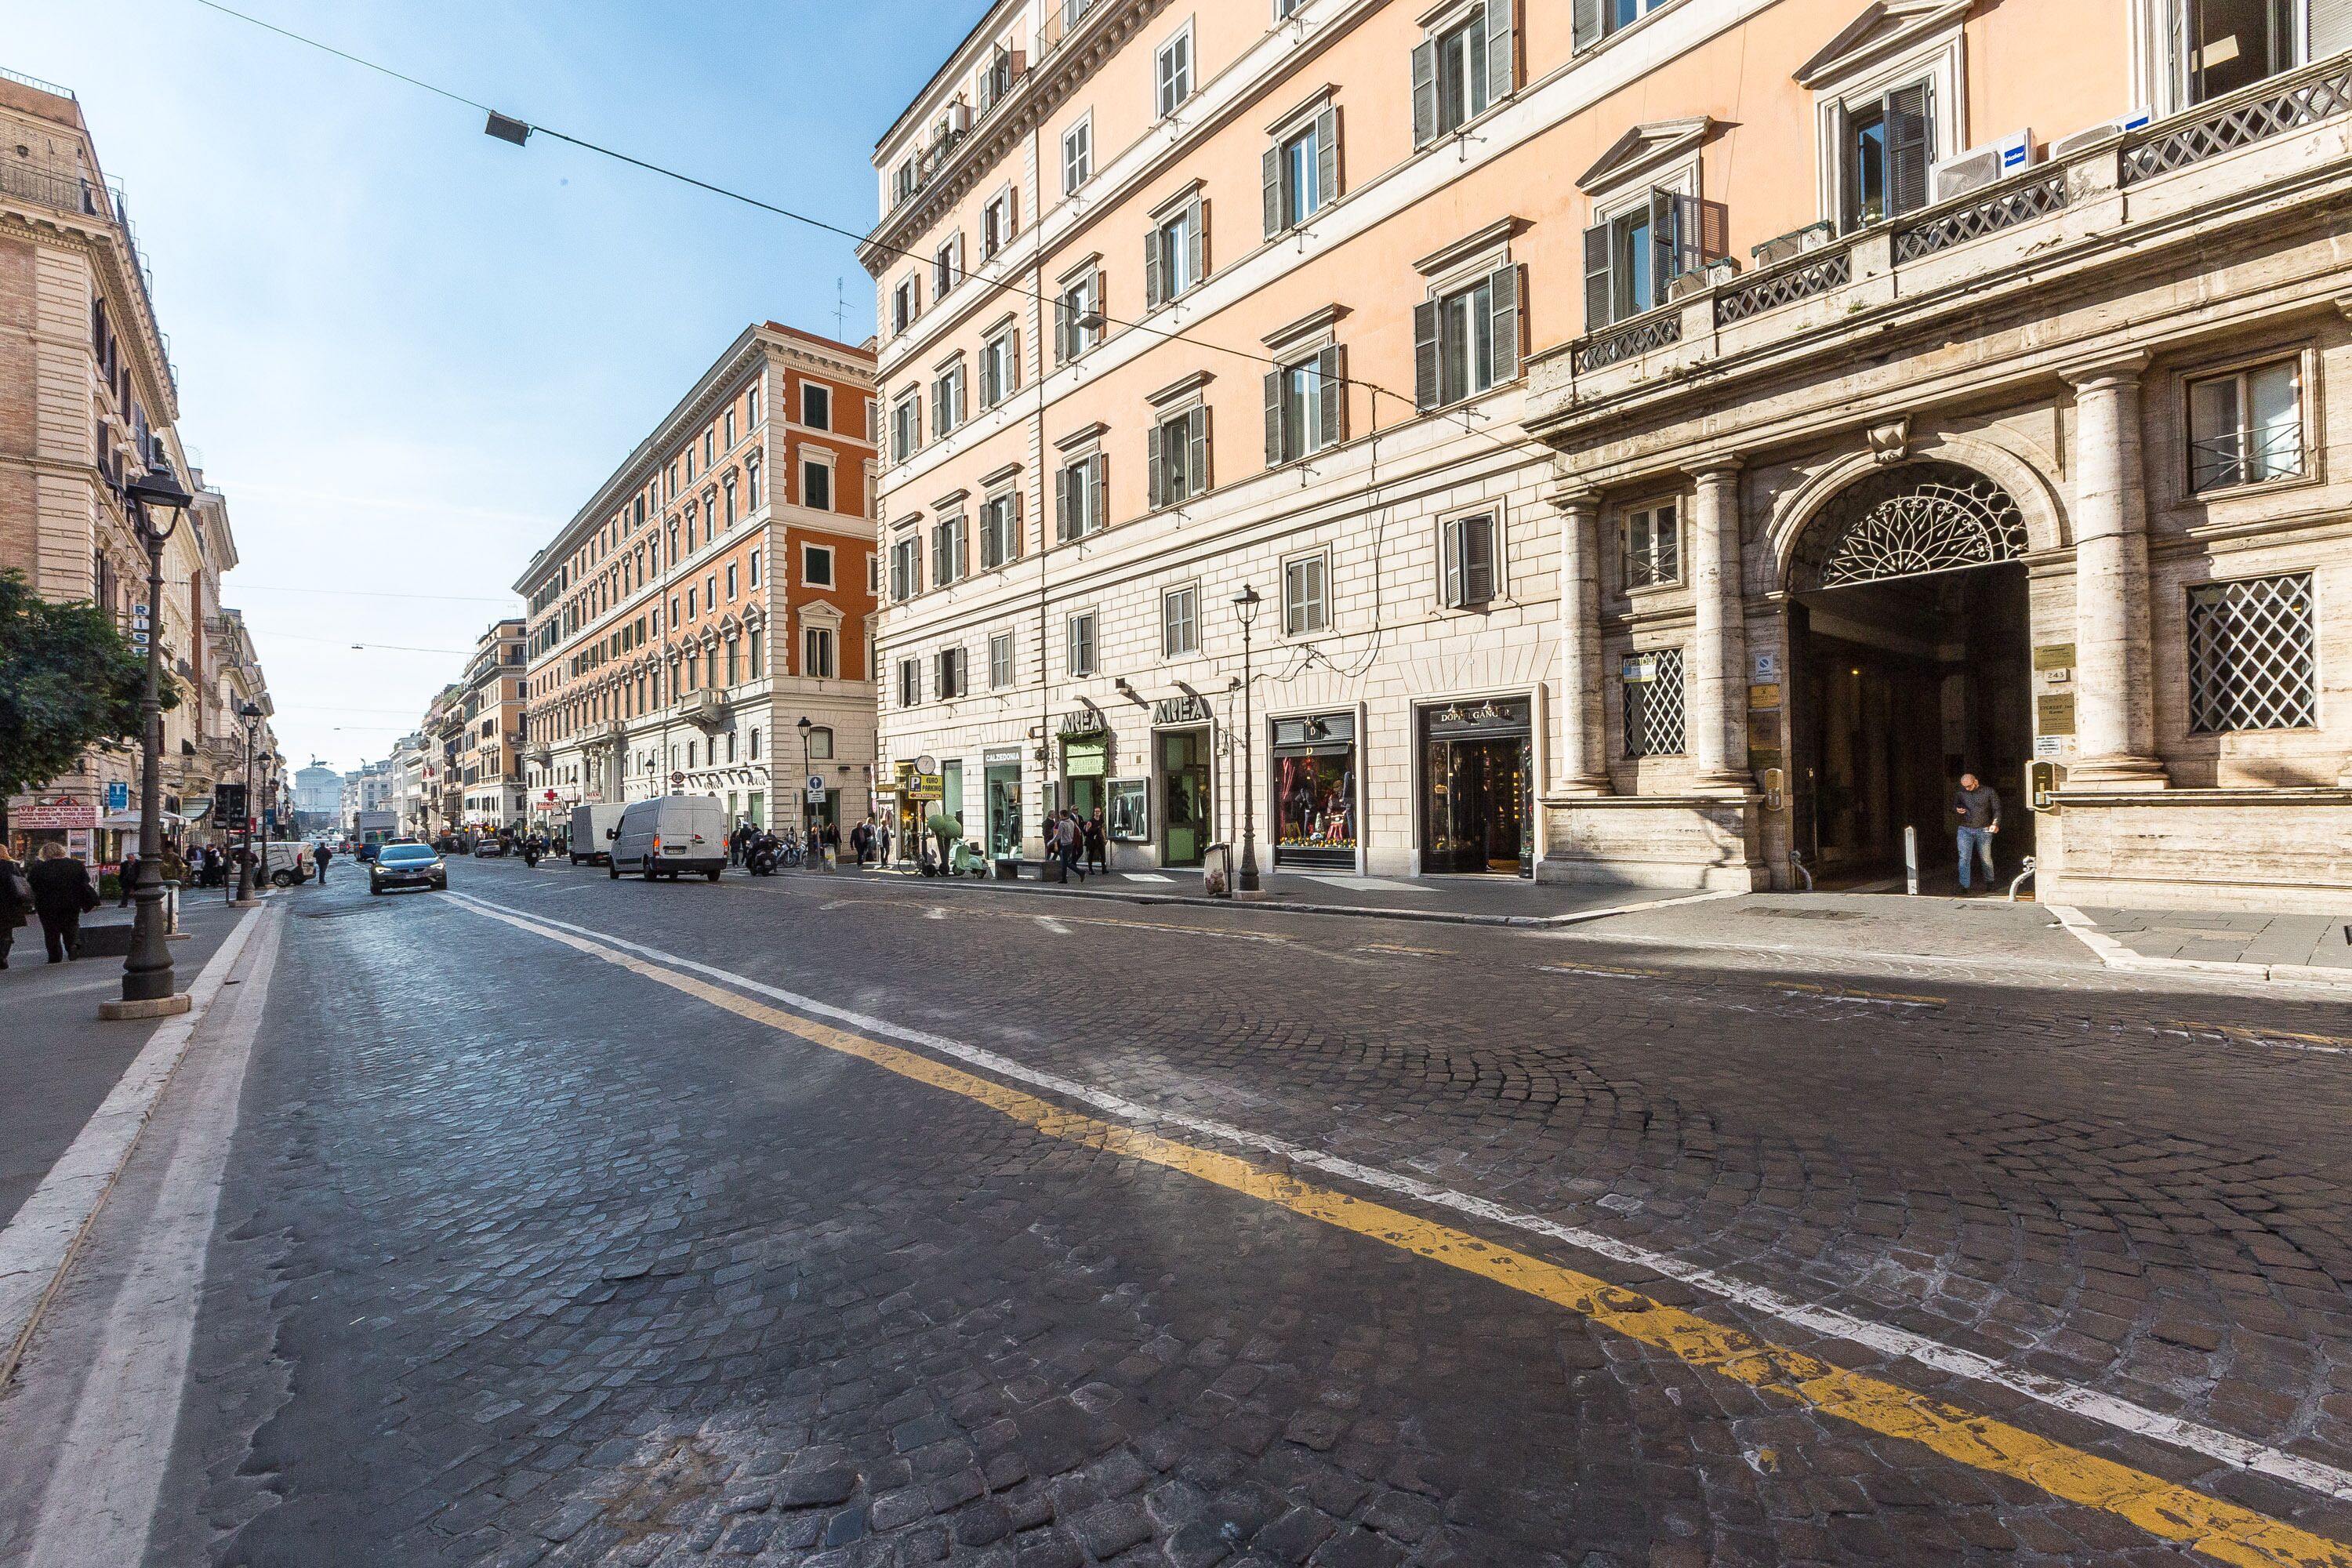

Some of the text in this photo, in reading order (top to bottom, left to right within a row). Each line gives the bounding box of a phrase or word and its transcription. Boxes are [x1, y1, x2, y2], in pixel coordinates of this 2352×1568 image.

[2005, 151, 2024, 163] Haier
[1152, 695, 1207, 723] AREA
[1059, 709, 1102, 733] AREA
[985, 752, 1020, 762] CALZEDONIA
[910, 777, 920, 789] P
